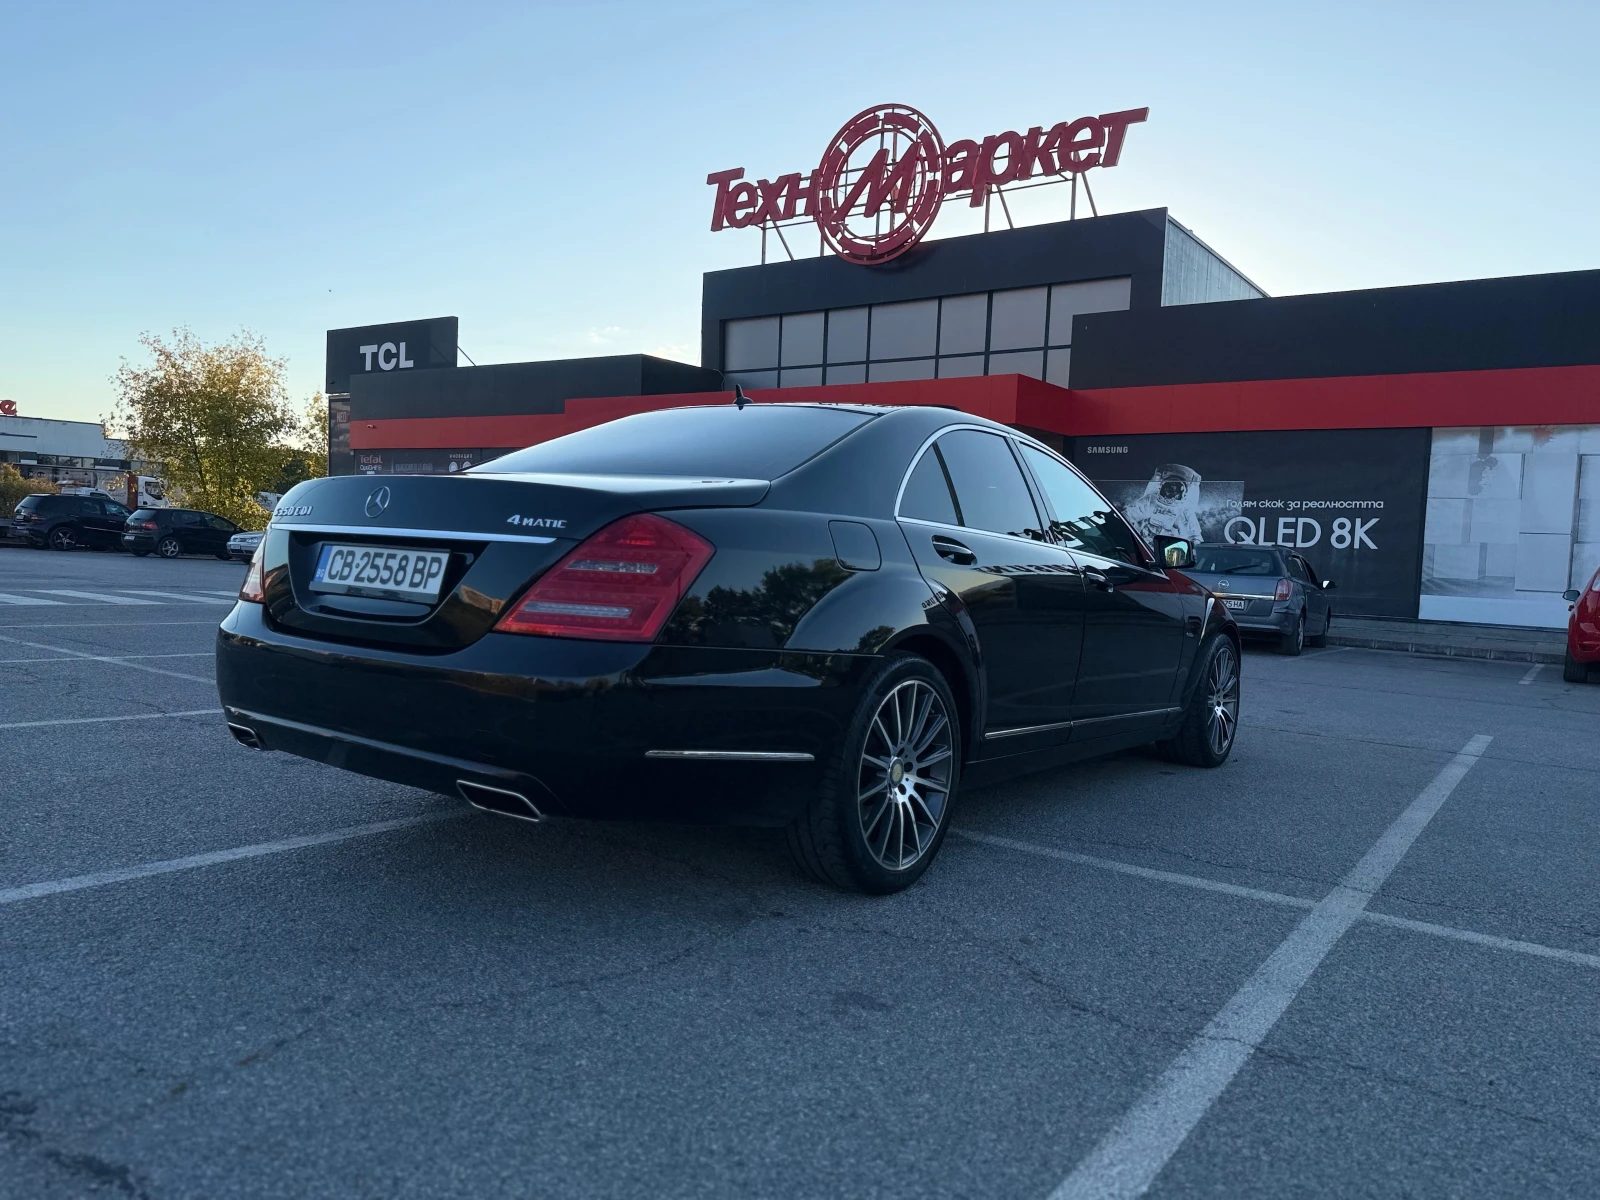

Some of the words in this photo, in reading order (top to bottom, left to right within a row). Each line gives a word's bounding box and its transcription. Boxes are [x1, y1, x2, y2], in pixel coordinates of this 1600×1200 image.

[359, 341, 414, 371] TCL
[1087, 446, 1129, 454] SAMSUNG
[360, 454, 383, 464] Tefal
[294, 505, 313, 516] CDI
[1226, 500, 1257, 509] Голям
[1258, 499, 1285, 509] скок
[1286, 500, 1301, 511] за
[1302, 499, 1384, 511] реалността
[507, 514, 568, 529] 4MATIC
[1223, 516, 1322, 548] QLED
[1330, 517, 1381, 550] 8K
